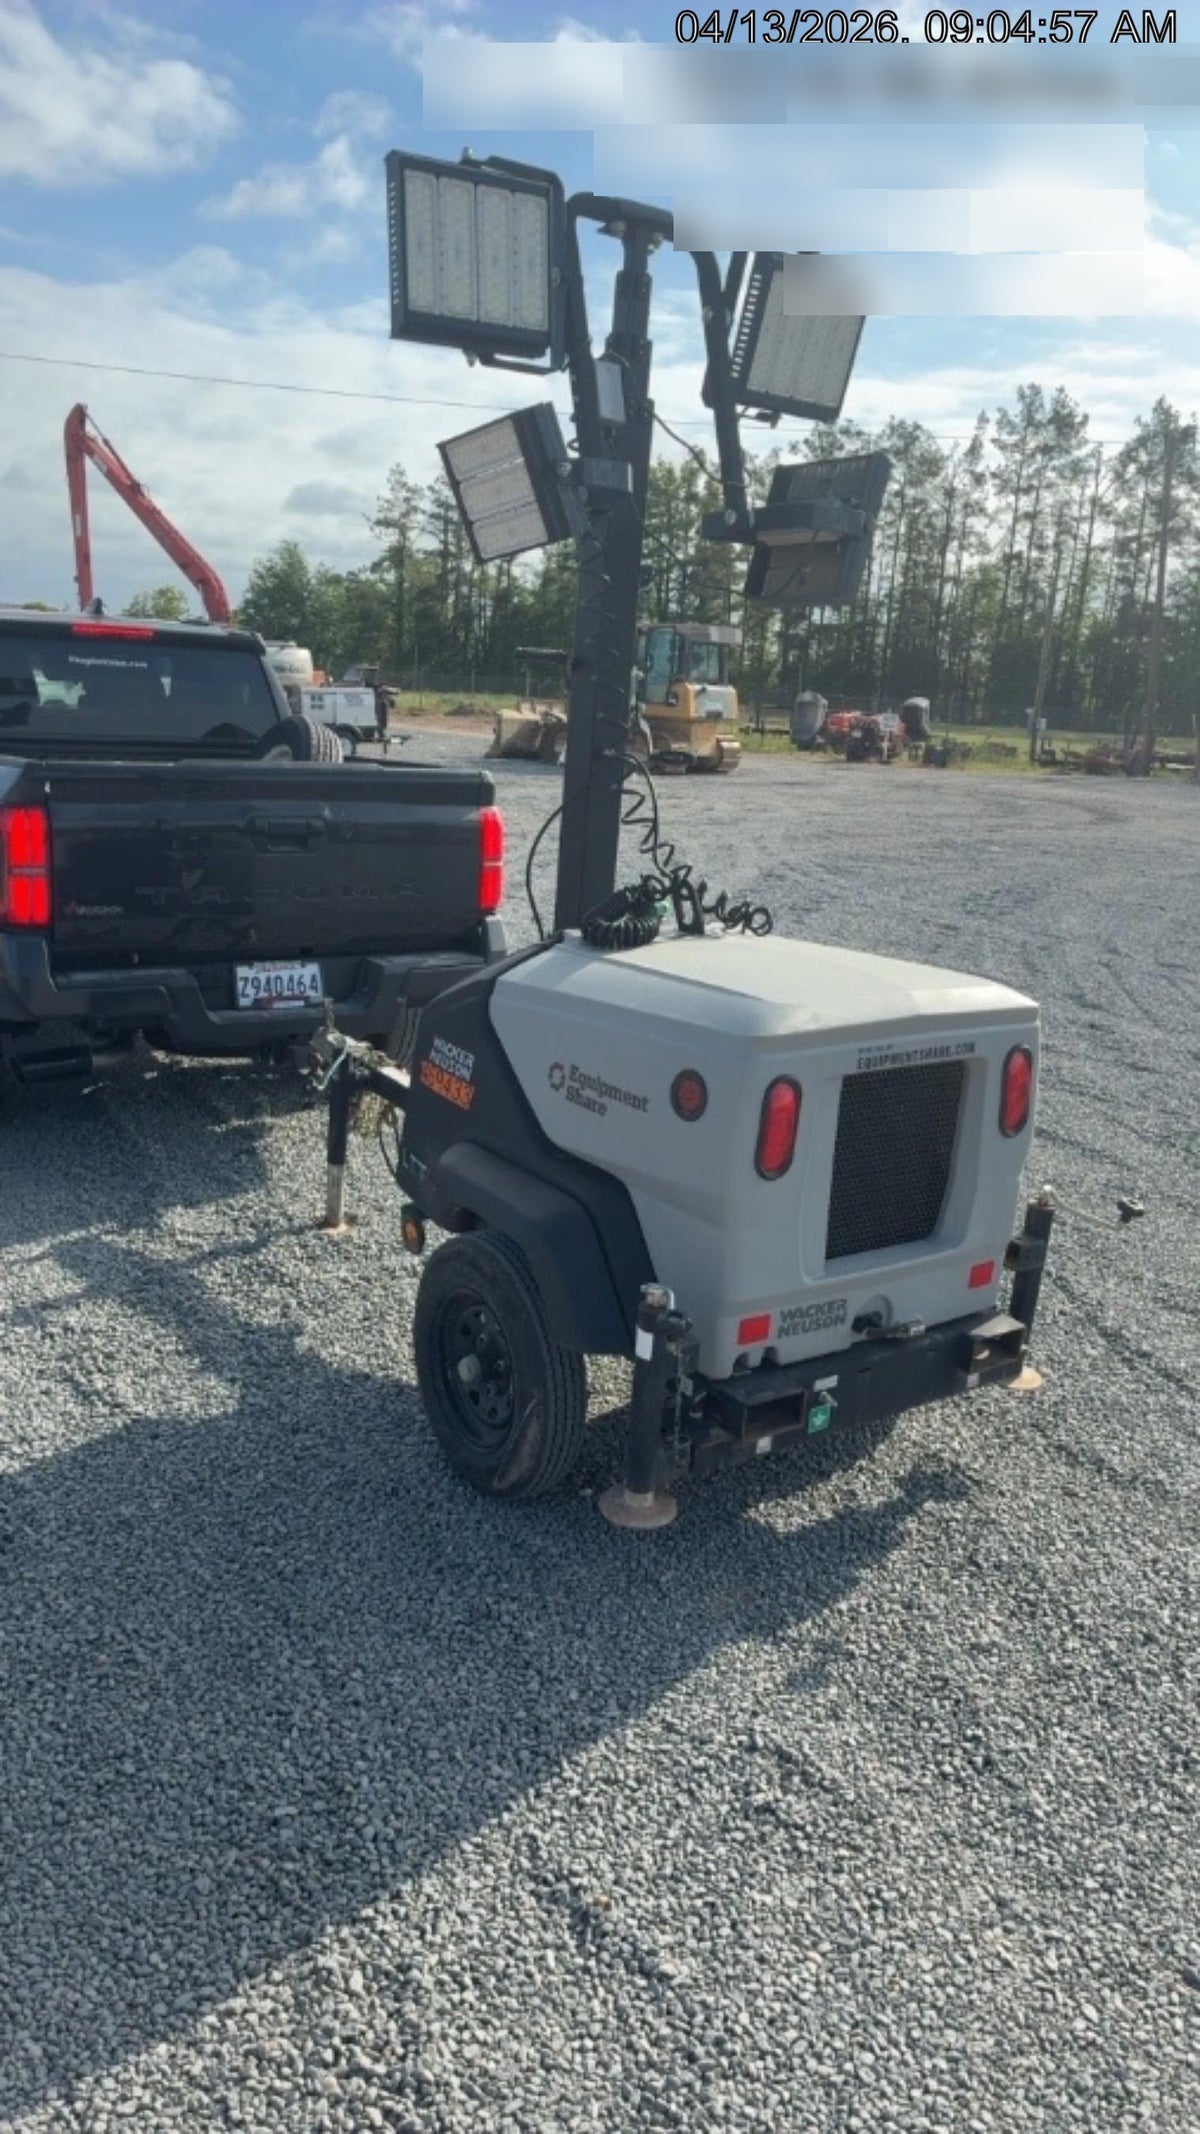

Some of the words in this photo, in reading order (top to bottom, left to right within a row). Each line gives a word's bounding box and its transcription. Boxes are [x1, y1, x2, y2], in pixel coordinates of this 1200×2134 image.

[239, 973, 319, 999] Z940464
[565, 1085, 608, 1117] Share
[568, 1064, 649, 1113] Equipment
[777, 1311, 846, 1339] NEUSON
[780, 1299, 848, 1323] WACKER
